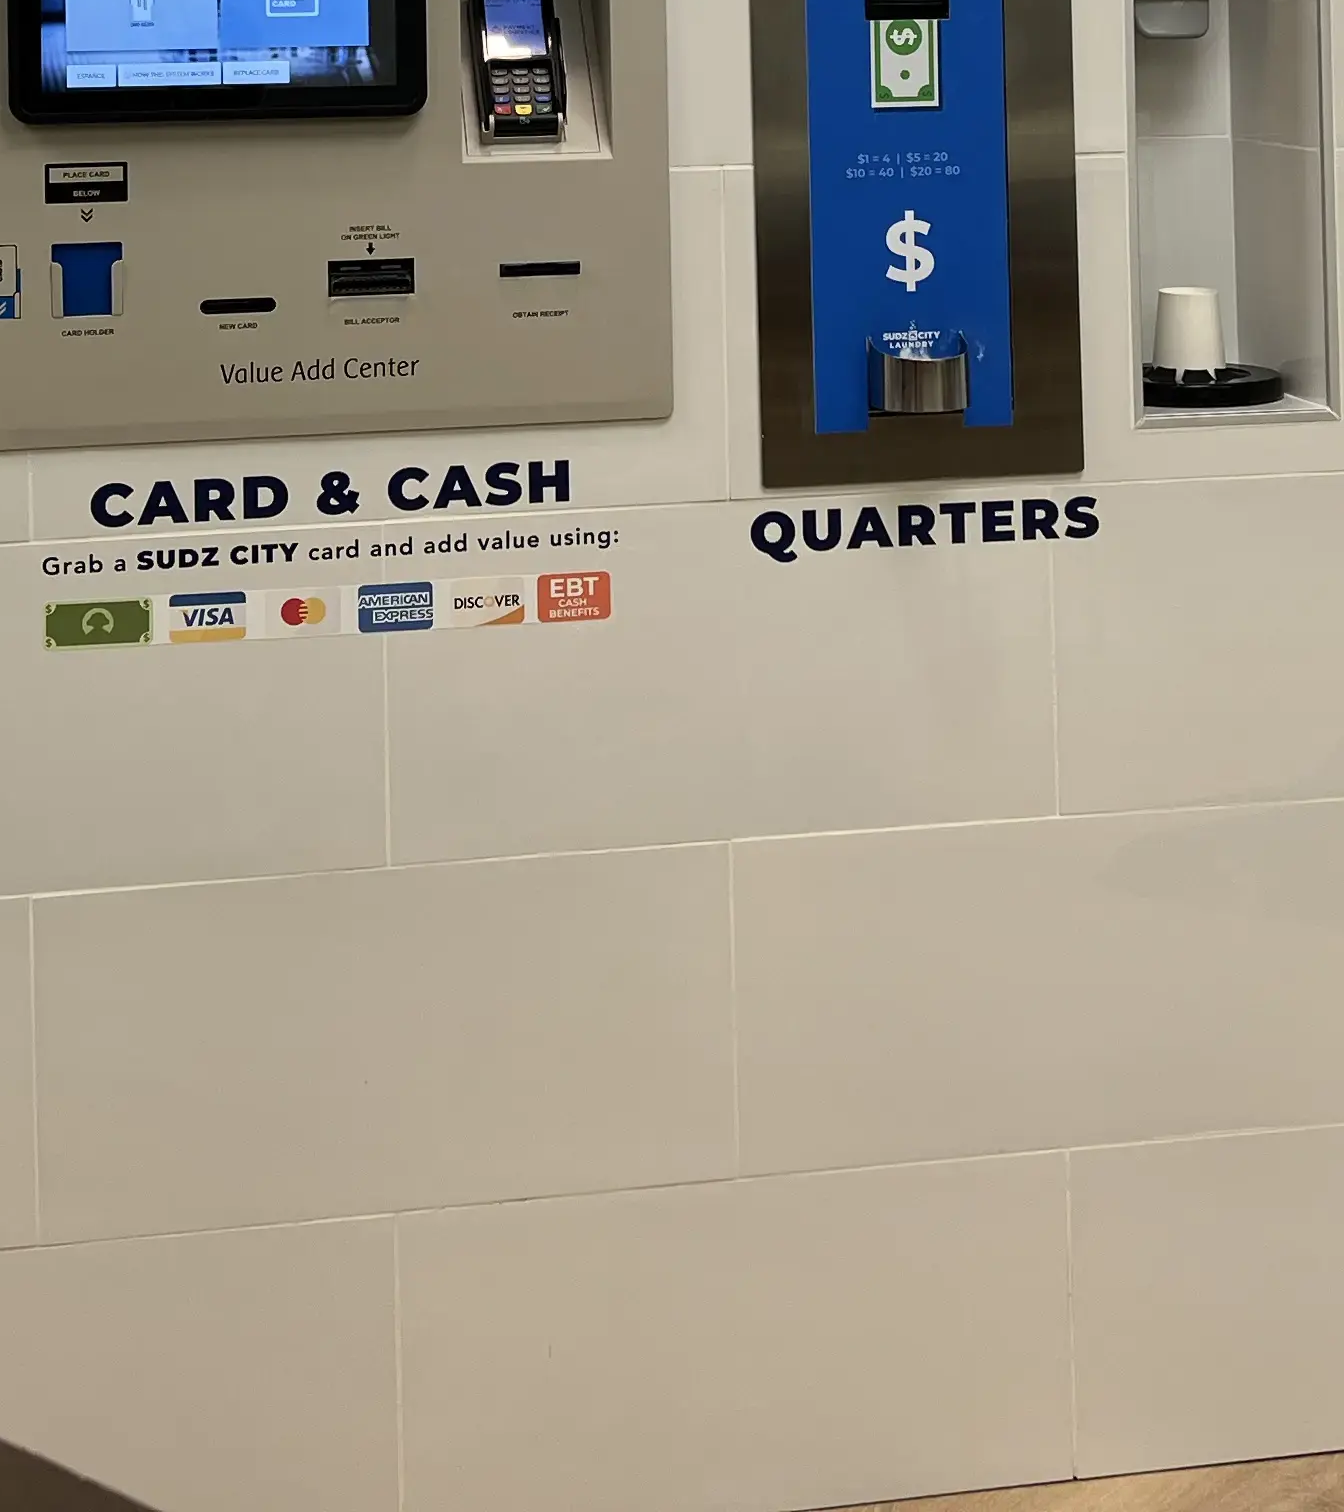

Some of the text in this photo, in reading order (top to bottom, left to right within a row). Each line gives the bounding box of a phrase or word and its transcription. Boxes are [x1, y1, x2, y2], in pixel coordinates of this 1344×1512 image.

[857, 153, 870, 164] $1
[882, 153, 891, 163] 4
[906, 152, 921, 163] $5
[933, 152, 949, 162] 20
[88, 170, 110, 178] CARD
[846, 167, 866, 179] $10
[878, 167, 895, 177] 40
[910, 166, 932, 177] $20
[944, 165, 961, 175] 80
[885, 210, 936, 292] $
[344, 317, 400, 326] BILL ACCEPTOR
[61, 328, 115, 337] CARD HOLDER
[882, 331, 941, 341] SUDZ CITY
[889, 340, 934, 349] LAUNDRY
[220, 357, 420, 384] Value Add Center
[89, 459, 570, 528] CARD & CASH
[750, 496, 1100, 563] QUARTERS
[42, 527, 620, 576] Grab a SUDZ CITY card and add value using:
[550, 576, 599, 598] EBT
[358, 593, 429, 608] AMERICAN
[454, 594, 520, 610] DISCOVER
[558, 597, 587, 608] CASH
[183, 607, 235, 627] VISA
[373, 608, 433, 623] EXPRESS
[549, 607, 600, 620] BENEFITS
